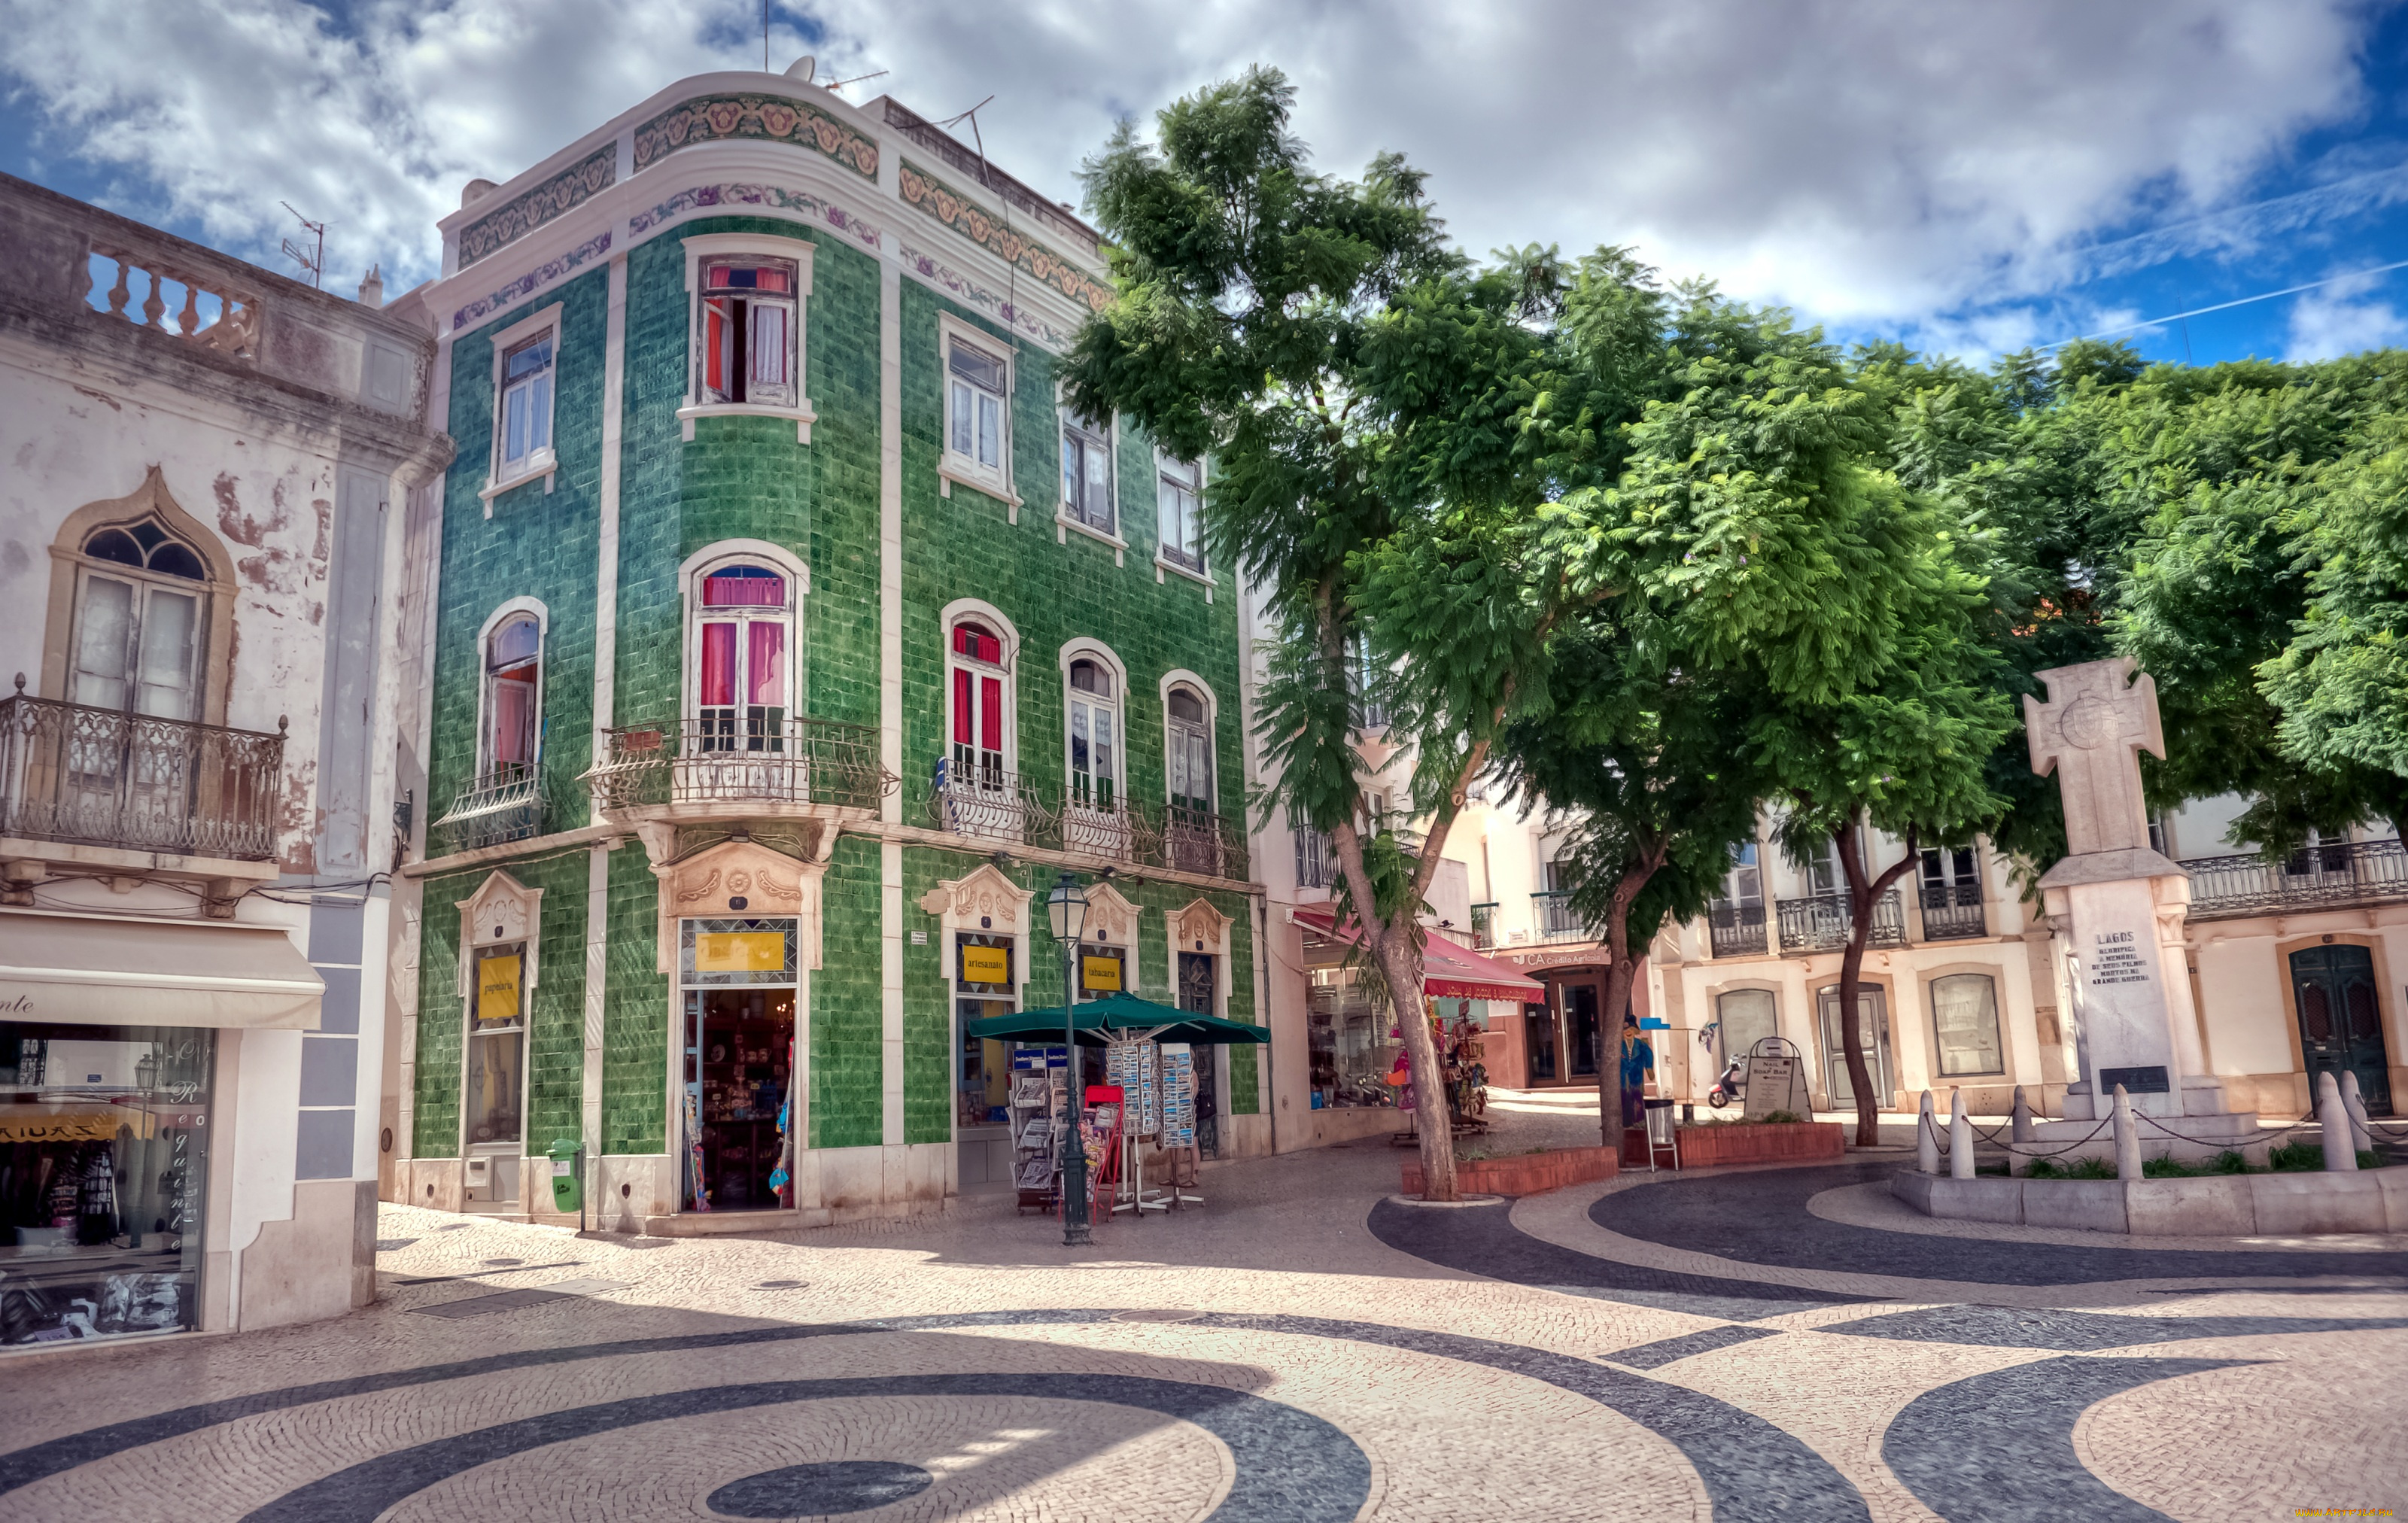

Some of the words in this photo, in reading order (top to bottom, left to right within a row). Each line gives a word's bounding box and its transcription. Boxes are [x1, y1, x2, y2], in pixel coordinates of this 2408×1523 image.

[2096, 932, 2134, 944] LAGOS
[2099, 946, 2136, 954] GLORIFICA
[968, 959, 1003, 969] artesanato
[1527, 953, 1545, 965] CA
[1547, 955, 1572, 965] Crédito
[1088, 968, 1115, 977] tabacaria
[485, 980, 512, 996] papelaria
